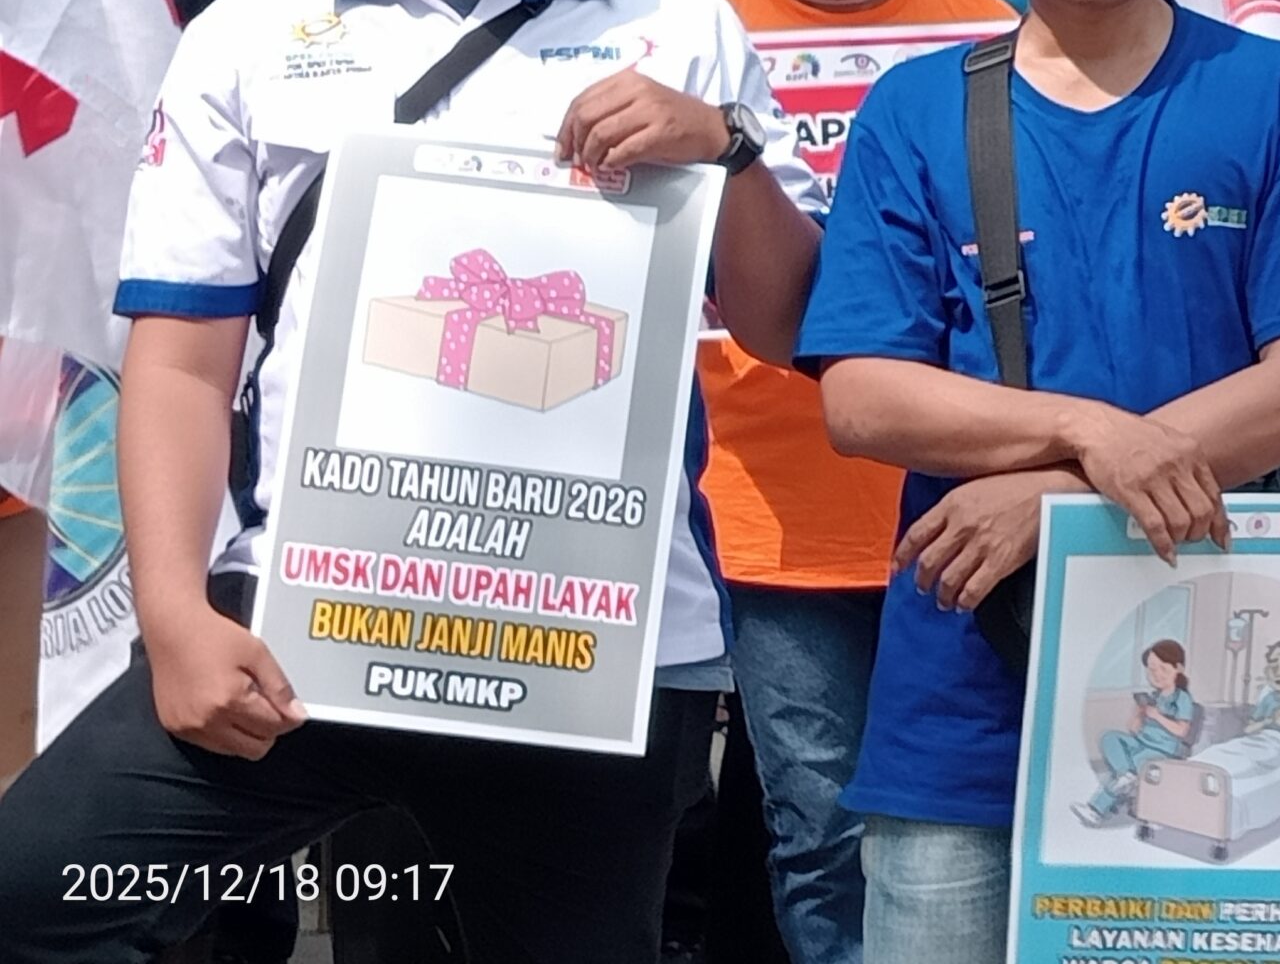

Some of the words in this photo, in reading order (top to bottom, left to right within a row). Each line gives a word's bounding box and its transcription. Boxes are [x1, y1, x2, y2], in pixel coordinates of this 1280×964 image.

[303, 449, 381, 493] KADO
[388, 459, 479, 507] TAHUN
[485, 472, 562, 514] BARU
[568, 484, 645, 526] 2026
[406, 510, 529, 558] ADALAH
[283, 547, 371, 590] UMSK
[380, 557, 443, 598] DAN
[452, 567, 533, 609] UPAH
[542, 578, 639, 622] LAYAK
[312, 605, 411, 649] BUKAN
[418, 617, 491, 658] JANJI
[500, 625, 596, 670] MANIS
[368, 666, 437, 699] PUK
[446, 676, 524, 708] MKP
[1034, 894, 1153, 919] PERBAIKI
[1071, 928, 1184, 951] LAYANAN
